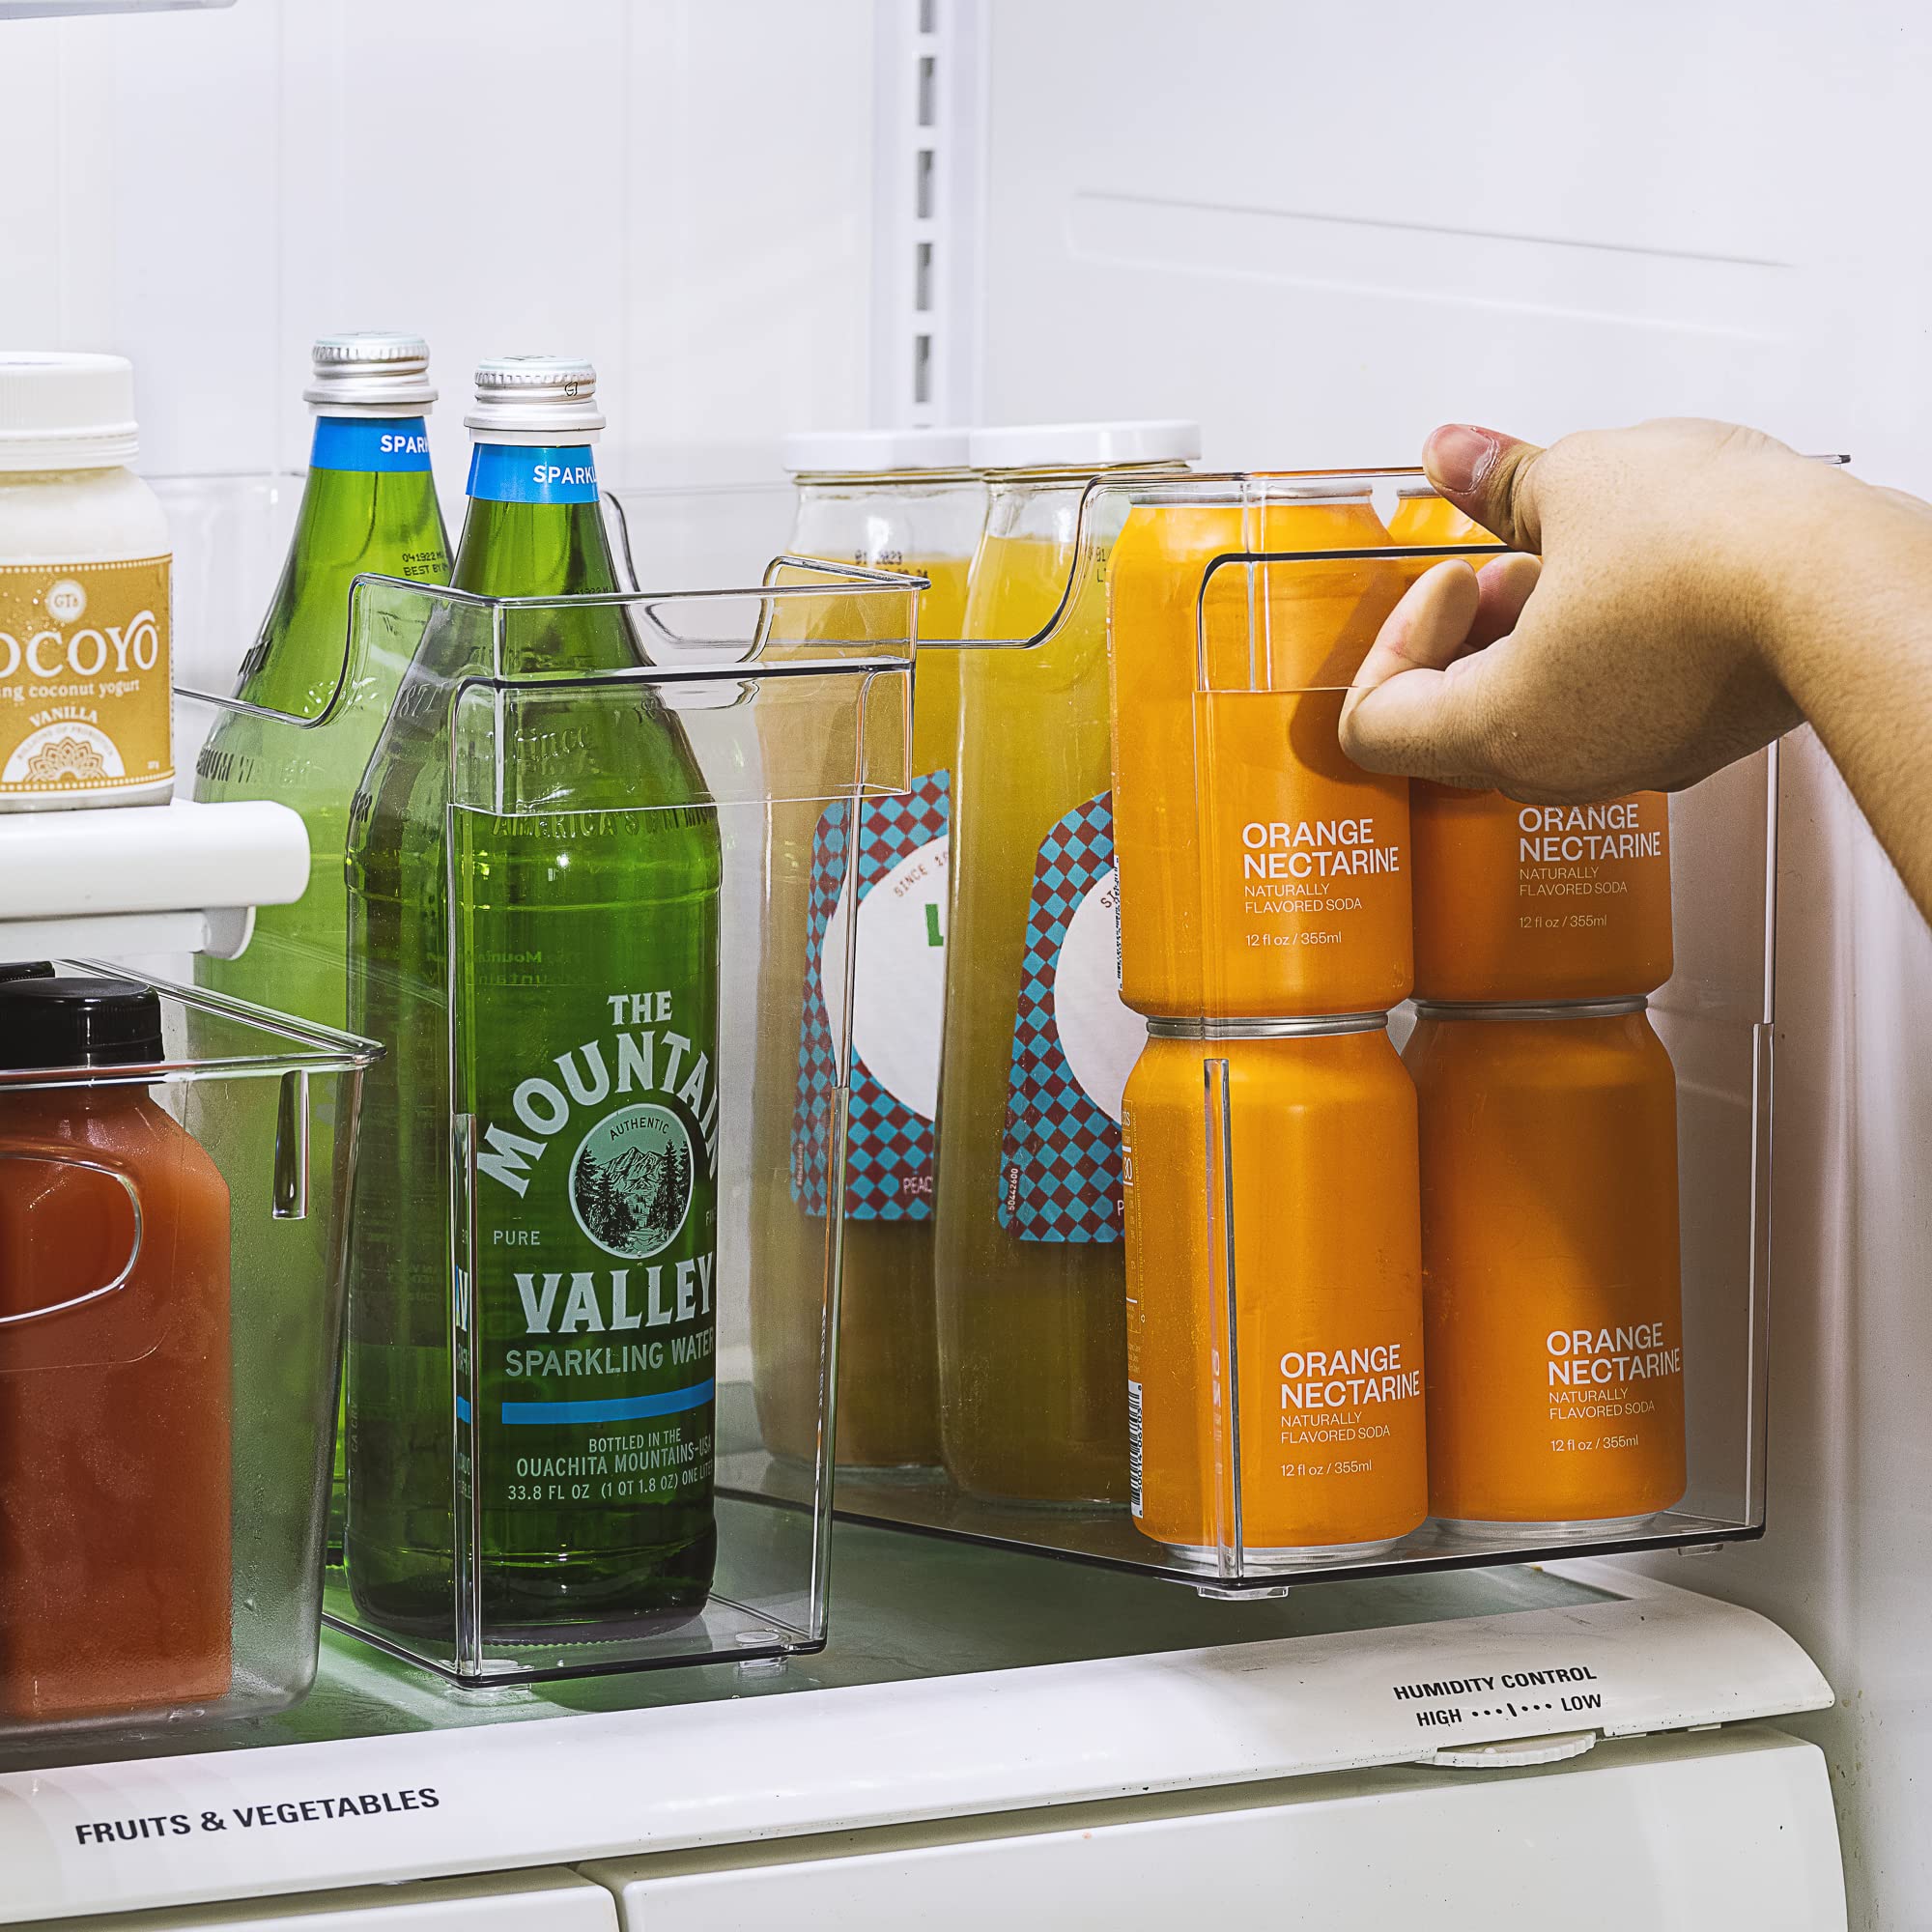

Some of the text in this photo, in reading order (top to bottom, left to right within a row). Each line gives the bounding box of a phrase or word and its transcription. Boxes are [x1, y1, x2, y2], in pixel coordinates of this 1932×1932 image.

[403, 564, 430, 577] BEST
[29, 682, 95, 698] coconut
[99, 678, 140, 699] yogurt
[29, 705, 99, 727] VANILLA
[1519, 803, 1639, 833] ORANGE
[1241, 818, 1375, 849] ORANGE
[1520, 831, 1662, 863] NECTARINE
[1243, 846, 1400, 879] NECTARINE
[1520, 866, 1600, 880] NATURALLY
[895, 864, 928, 897] SINCE
[1244, 883, 1330, 897] NATURALLY
[1520, 881, 1628, 896] FLAVORED SODA
[1245, 897, 1362, 914] FLAVORED SODA
[1519, 917, 1532, 928] 12
[1534, 916, 1543, 928] fl
[1545, 918, 1559, 928] oz
[1570, 914, 1607, 927] 355ml
[1245, 934, 1261, 947] 12
[1263, 933, 1271, 946] fl
[1273, 935, 1290, 946] oz
[1300, 930, 1342, 945] 355ml
[607, 990, 673, 1026] THE
[609, 1117, 669, 1142] AUTHENTIC
[494, 1230, 541, 1246] PURE
[514, 1252, 713, 1334] VALLEY
[1547, 1321, 1663, 1356] ORANGE
[505, 1342, 664, 1378] SPARKLING
[1280, 1344, 1401, 1378] ORANGE
[1548, 1347, 1681, 1386] NECTARINE
[1281, 1370, 1420, 1409] NECTARINE
[1548, 1387, 1629, 1404] NATURALLY
[1281, 1411, 1362, 1428] NATURALLY
[1549, 1400, 1655, 1420] FLAVORED SODA
[588, 1428, 681, 1454] BOTTLED IN THE
[1281, 1424, 1391, 1444] FLAVORED SODA
[1550, 1439, 1565, 1452] 12
[1567, 1438, 1576, 1451] fl
[1577, 1440, 1593, 1451] oz
[1603, 1434, 1639, 1449] 355ml
[516, 1456, 608, 1477] OUACHITA
[1280, 1463, 1295, 1477] 12
[1297, 1463, 1306, 1476] fl
[1308, 1464, 1323, 1476] oz
[1334, 1459, 1372, 1474] 355ml
[507, 1485, 543, 1500] 33.8
[548, 1485, 565, 1500] FL
[571, 1483, 590, 1499] OZ
[601, 1482, 613, 1499] (1
[617, 1479, 634, 1496] QT
[638, 1476, 655, 1493] 1.8
[660, 1472, 678, 1491] OZ)
[681, 1466, 698, 1486] ONE
[1392, 1666, 1597, 1700] HUMIDITY CONTROL
[1416, 1693, 1602, 1727] HIGH LOW
[75, 1787, 440, 1845] FRUITS & VEGETABLES
